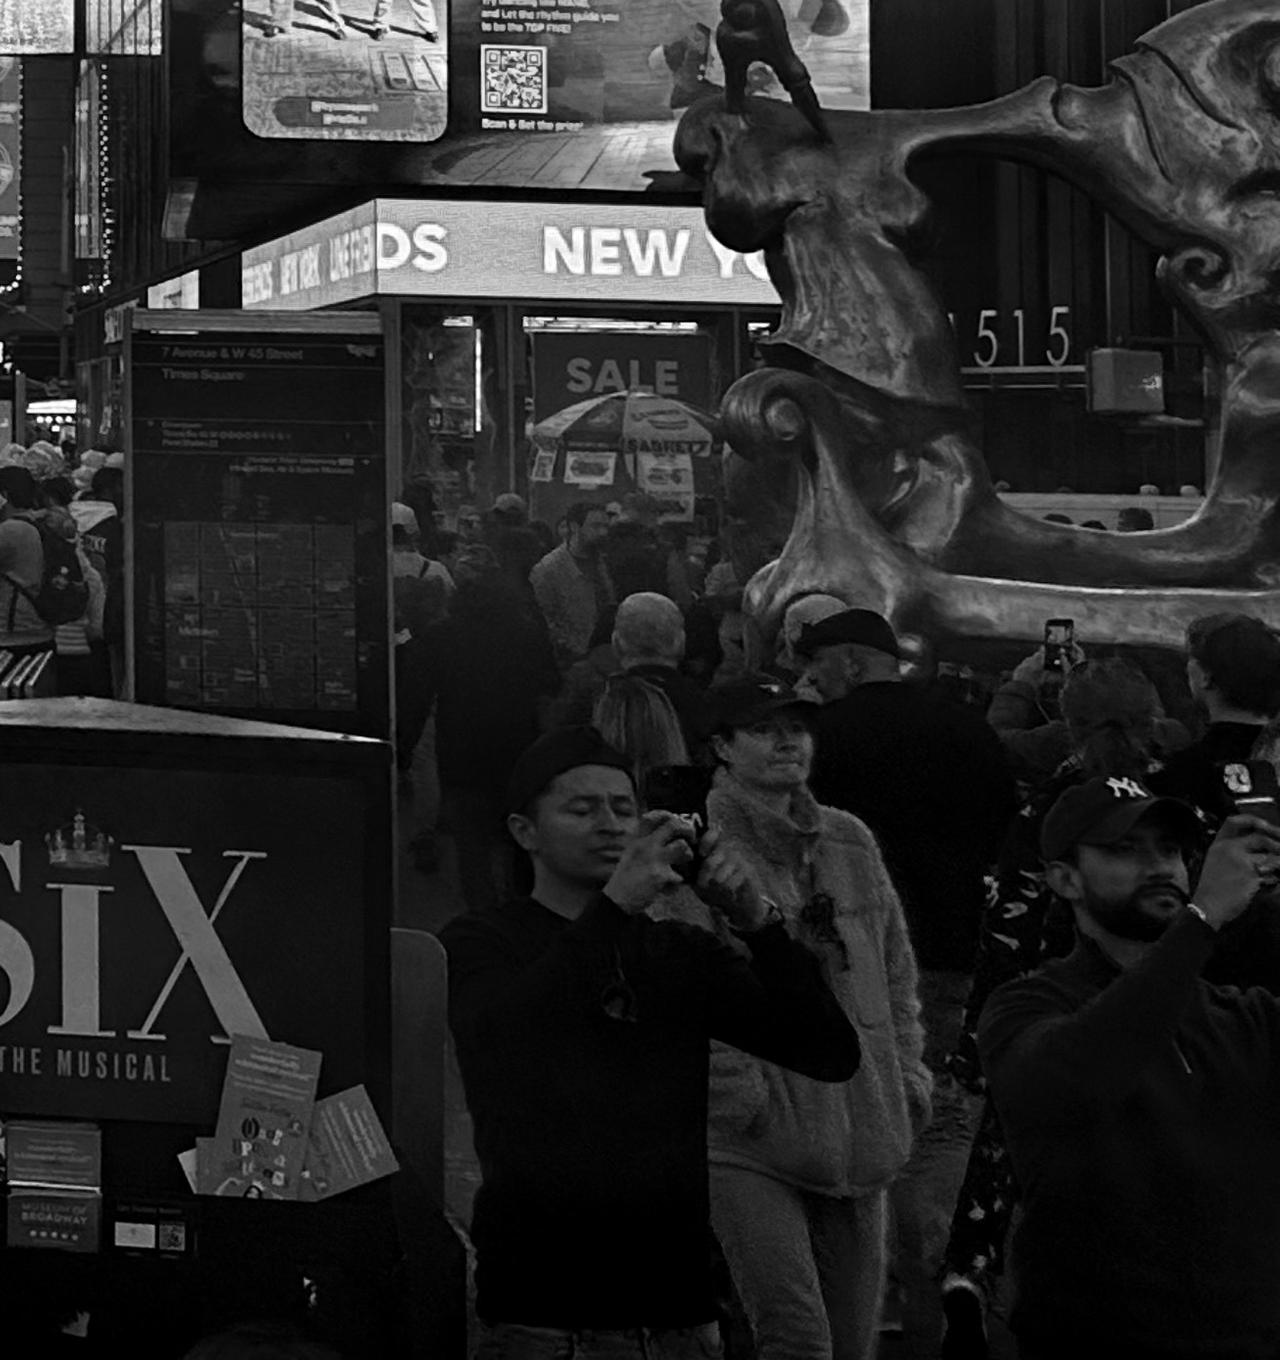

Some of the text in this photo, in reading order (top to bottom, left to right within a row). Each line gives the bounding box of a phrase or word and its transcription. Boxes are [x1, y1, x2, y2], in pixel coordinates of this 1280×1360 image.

[543, 225, 691, 278] NEW
[161, 346, 304, 360] 7 Avenue & W 45 Street
[947, 306, 1071, 367] 515
[162, 368, 245, 383] Times Square
[566, 357, 680, 397] SALE
[1105, 776, 1149, 799] NY
[56, 1047, 172, 1084] MUSICAL
